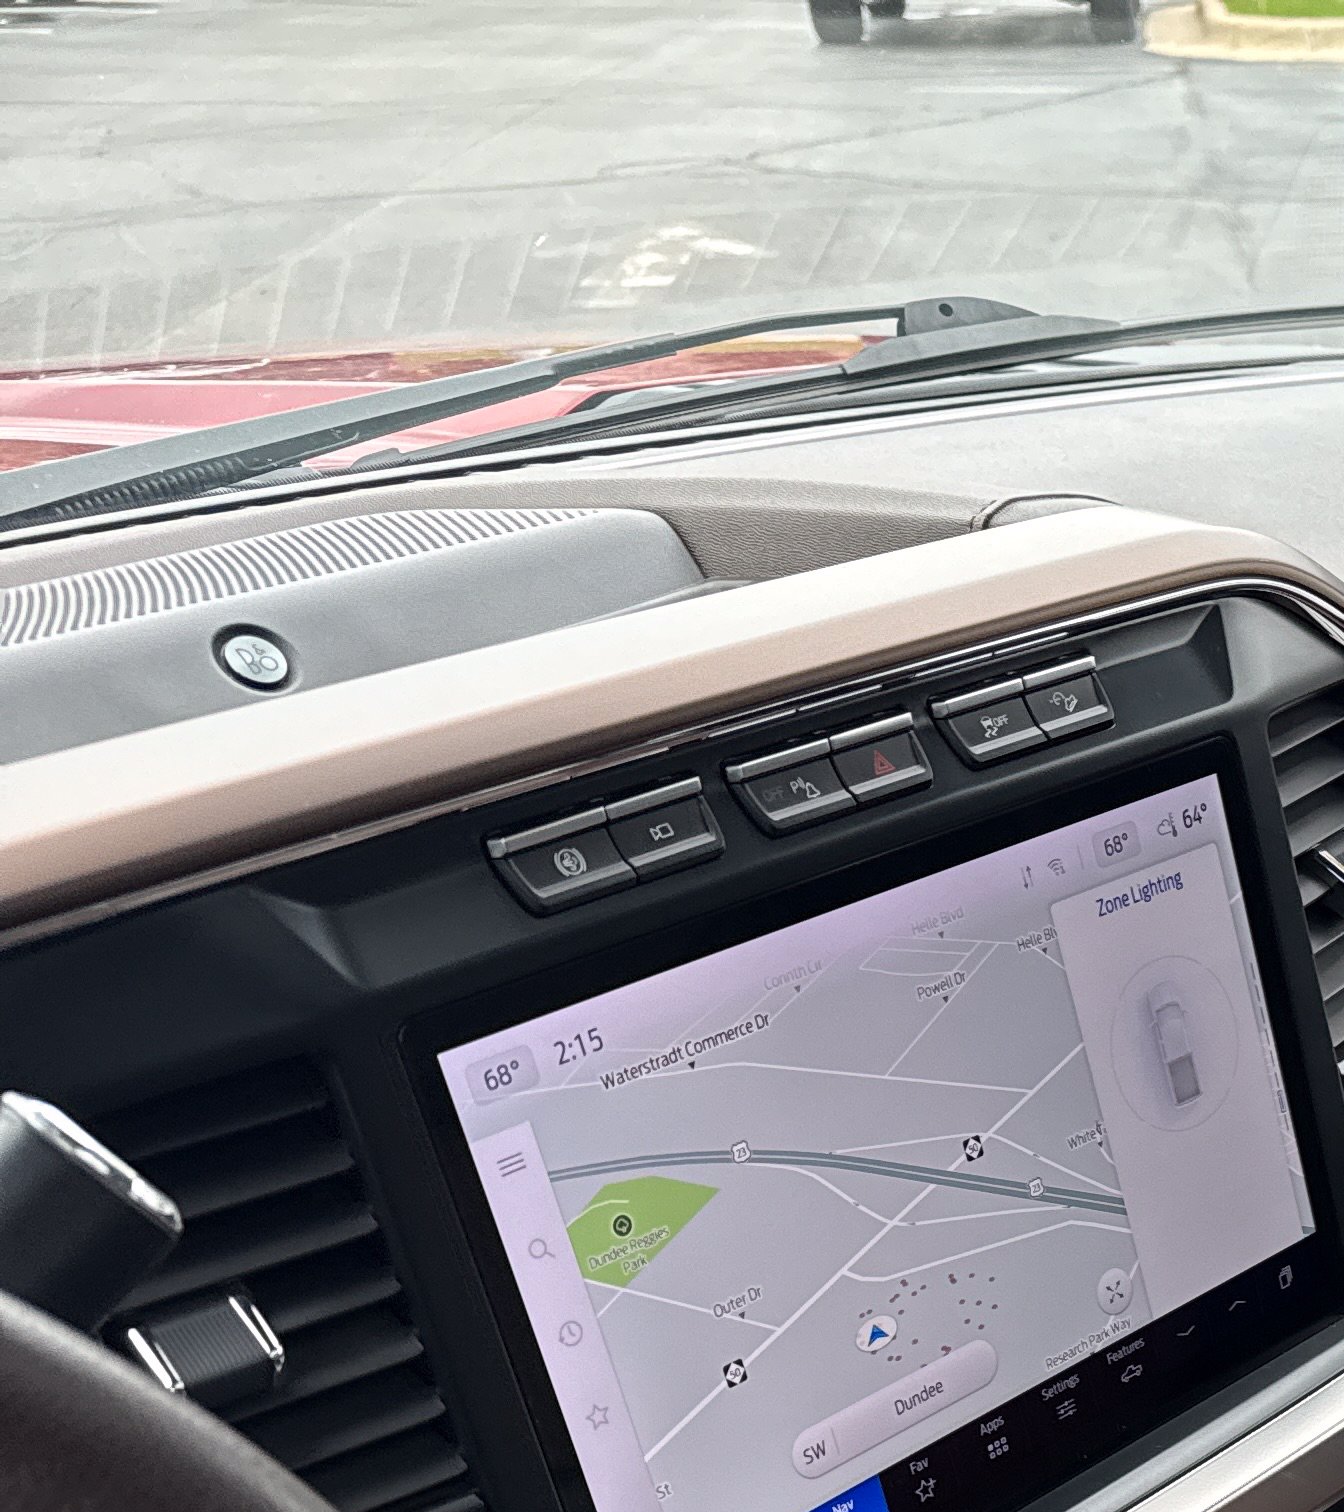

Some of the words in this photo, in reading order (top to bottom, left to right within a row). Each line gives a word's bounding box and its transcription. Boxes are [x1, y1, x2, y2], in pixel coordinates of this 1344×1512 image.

[993, 713, 1009, 728] OFF
[1181, 802, 1208, 829] 64°
[1104, 832, 1129, 857] 68°
[1097, 890, 1131, 918] Zone
[1131, 872, 1183, 906] Lighting
[941, 906, 965, 925] Blvd
[1017, 931, 1042, 951] Helle
[917, 976, 953, 1000] Powell
[953, 971, 966, 987] Dr
[554, 1027, 603, 1065] 2:15
[600, 1047, 684, 1090] Waterstradt
[685, 1021, 753, 1057] Commerce
[754, 1013, 770, 1030] Dr
[484, 1060, 519, 1091] 68°
[589, 1244, 629, 1270] Dundee
[622, 1255, 648, 1274] Park
[713, 1293, 748, 1318] Outer
[749, 1287, 762, 1302] Dr
[1045, 1340, 1089, 1370] Research
[1088, 1327, 1111, 1347] Park
[1110, 1318, 1131, 1335] Way
[1106, 1337, 1146, 1365] Features
[895, 1380, 944, 1416] Dundee
[1041, 1373, 1080, 1401] Settings
[980, 1415, 1005, 1437] Apps
[802, 1441, 827, 1466] SW
[909, 1456, 930, 1476] Fav
[655, 1481, 673, 1500] St
